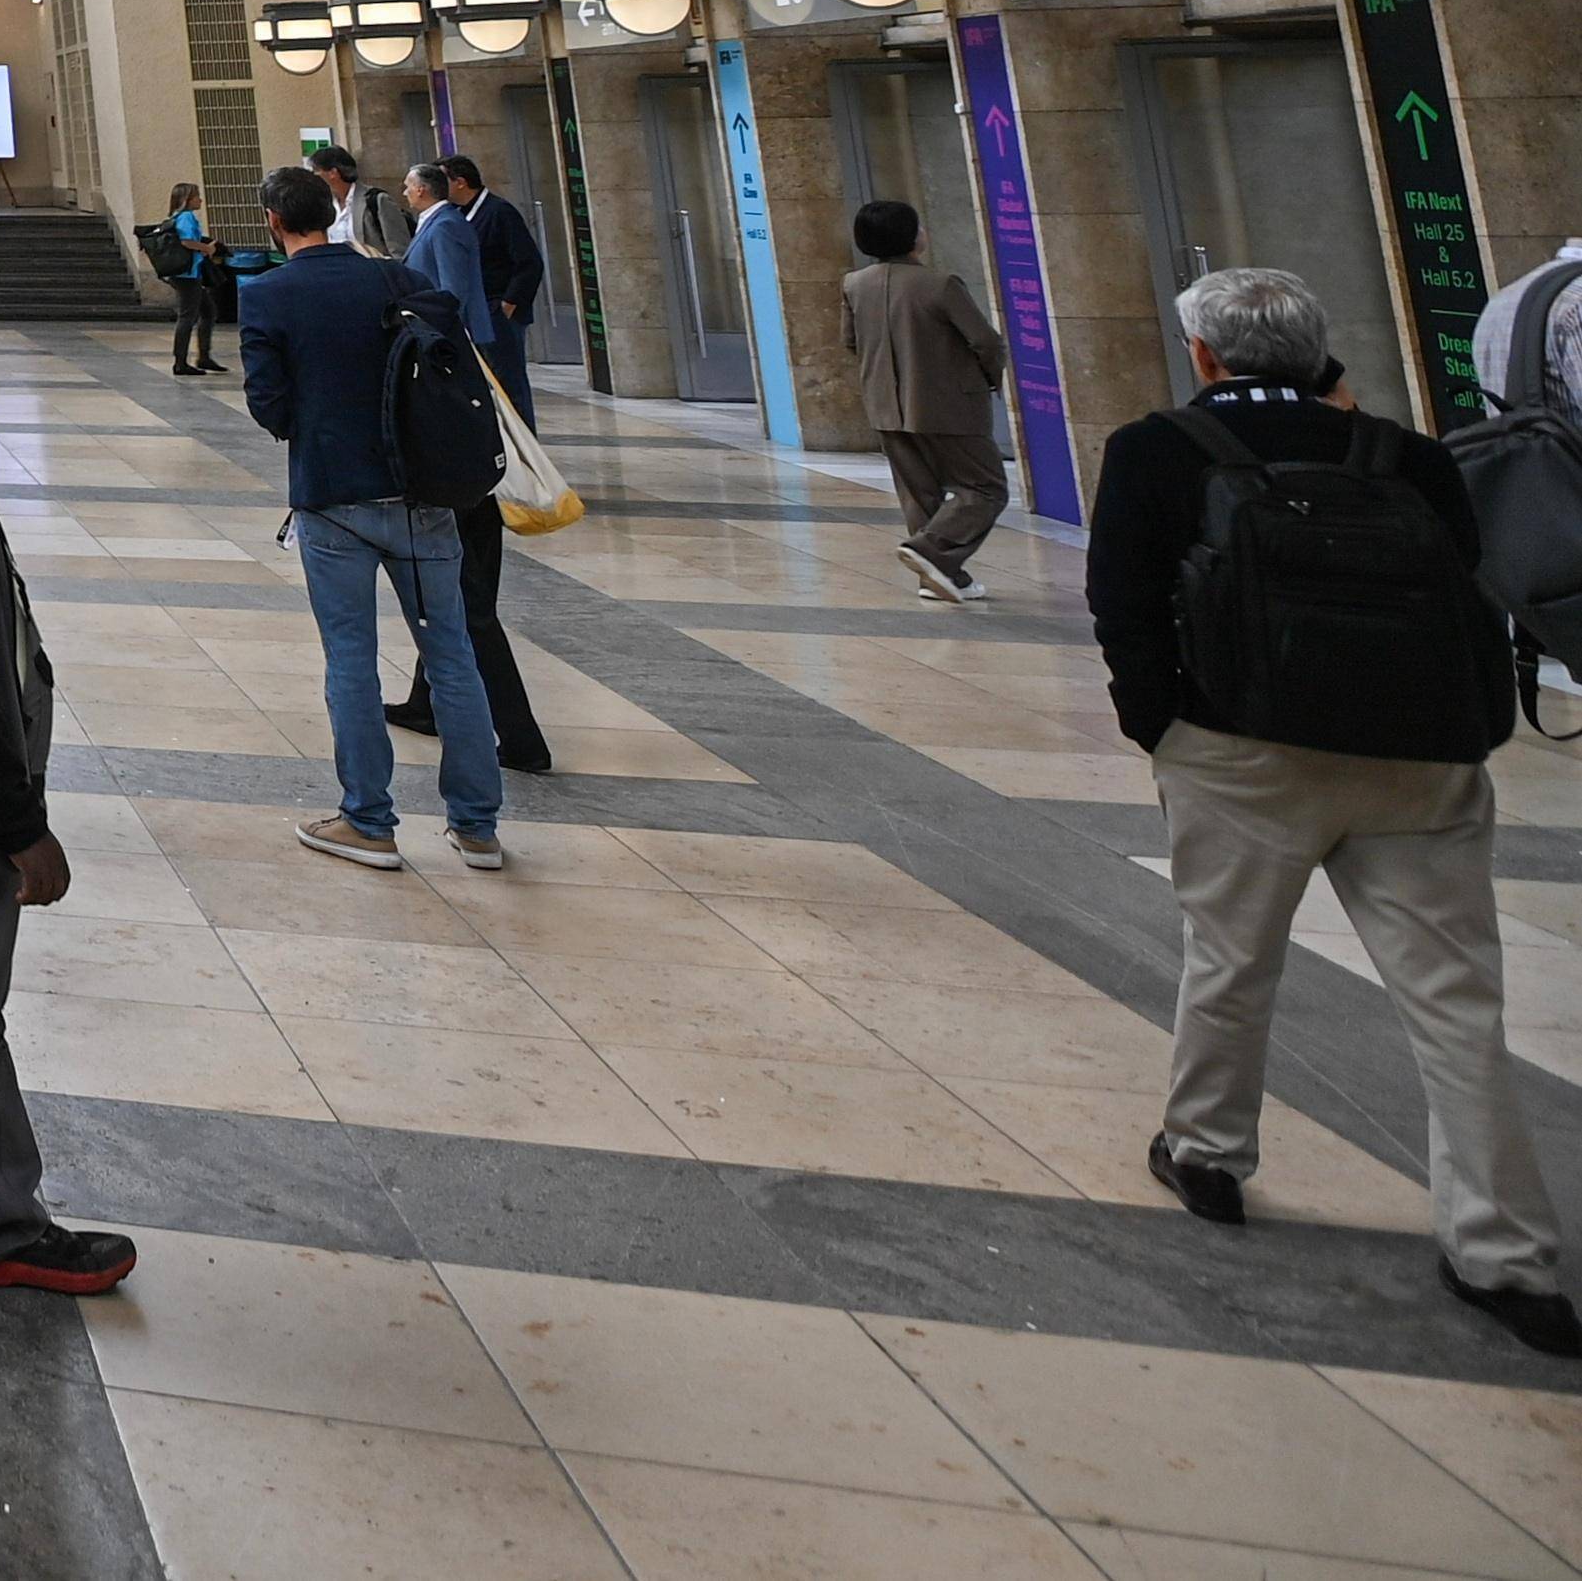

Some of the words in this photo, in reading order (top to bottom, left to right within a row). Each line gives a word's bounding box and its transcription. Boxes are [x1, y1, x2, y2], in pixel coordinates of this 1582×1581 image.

[1405, 191, 1427, 211] IFA
[1429, 192, 1463, 213] Next
[1414, 222, 1443, 241] Hall
[1445, 224, 1466, 242] 25
[1438, 246, 1450, 263] &
[1421, 268, 1450, 286] Hall
[1452, 270, 1476, 289] 5.2
[1438, 332, 1473, 355] Drea
[1445, 356, 1479, 383] Stag
